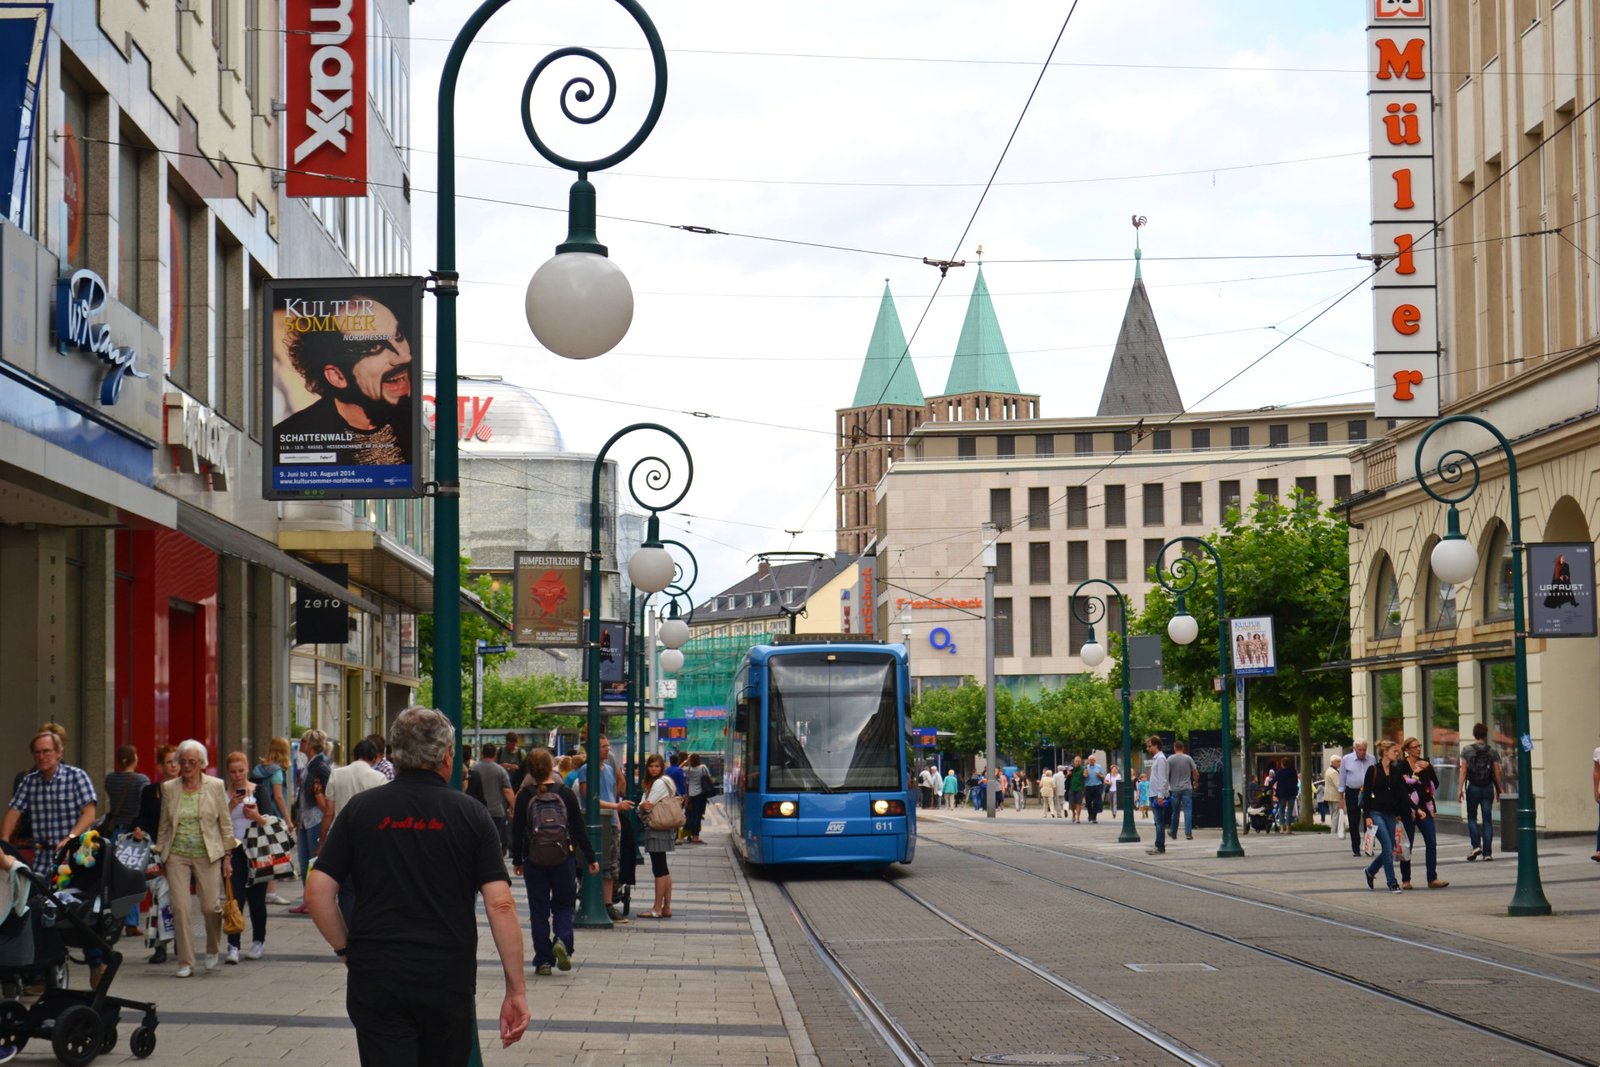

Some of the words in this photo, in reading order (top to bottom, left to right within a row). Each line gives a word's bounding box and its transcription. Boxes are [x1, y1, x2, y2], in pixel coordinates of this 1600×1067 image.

[1375, 38, 1425, 401] Müller
[284, 298, 375, 318] KULTUR
[285, 315, 376, 332] SOMMER
[279, 433, 353, 442] SCHATTENWALD
[320, 470, 338, 478] August
[519, 556, 580, 566] RUMPELSTILZCHEN
[304, 599, 341, 609] zero
[875, 822, 893, 831] 611
